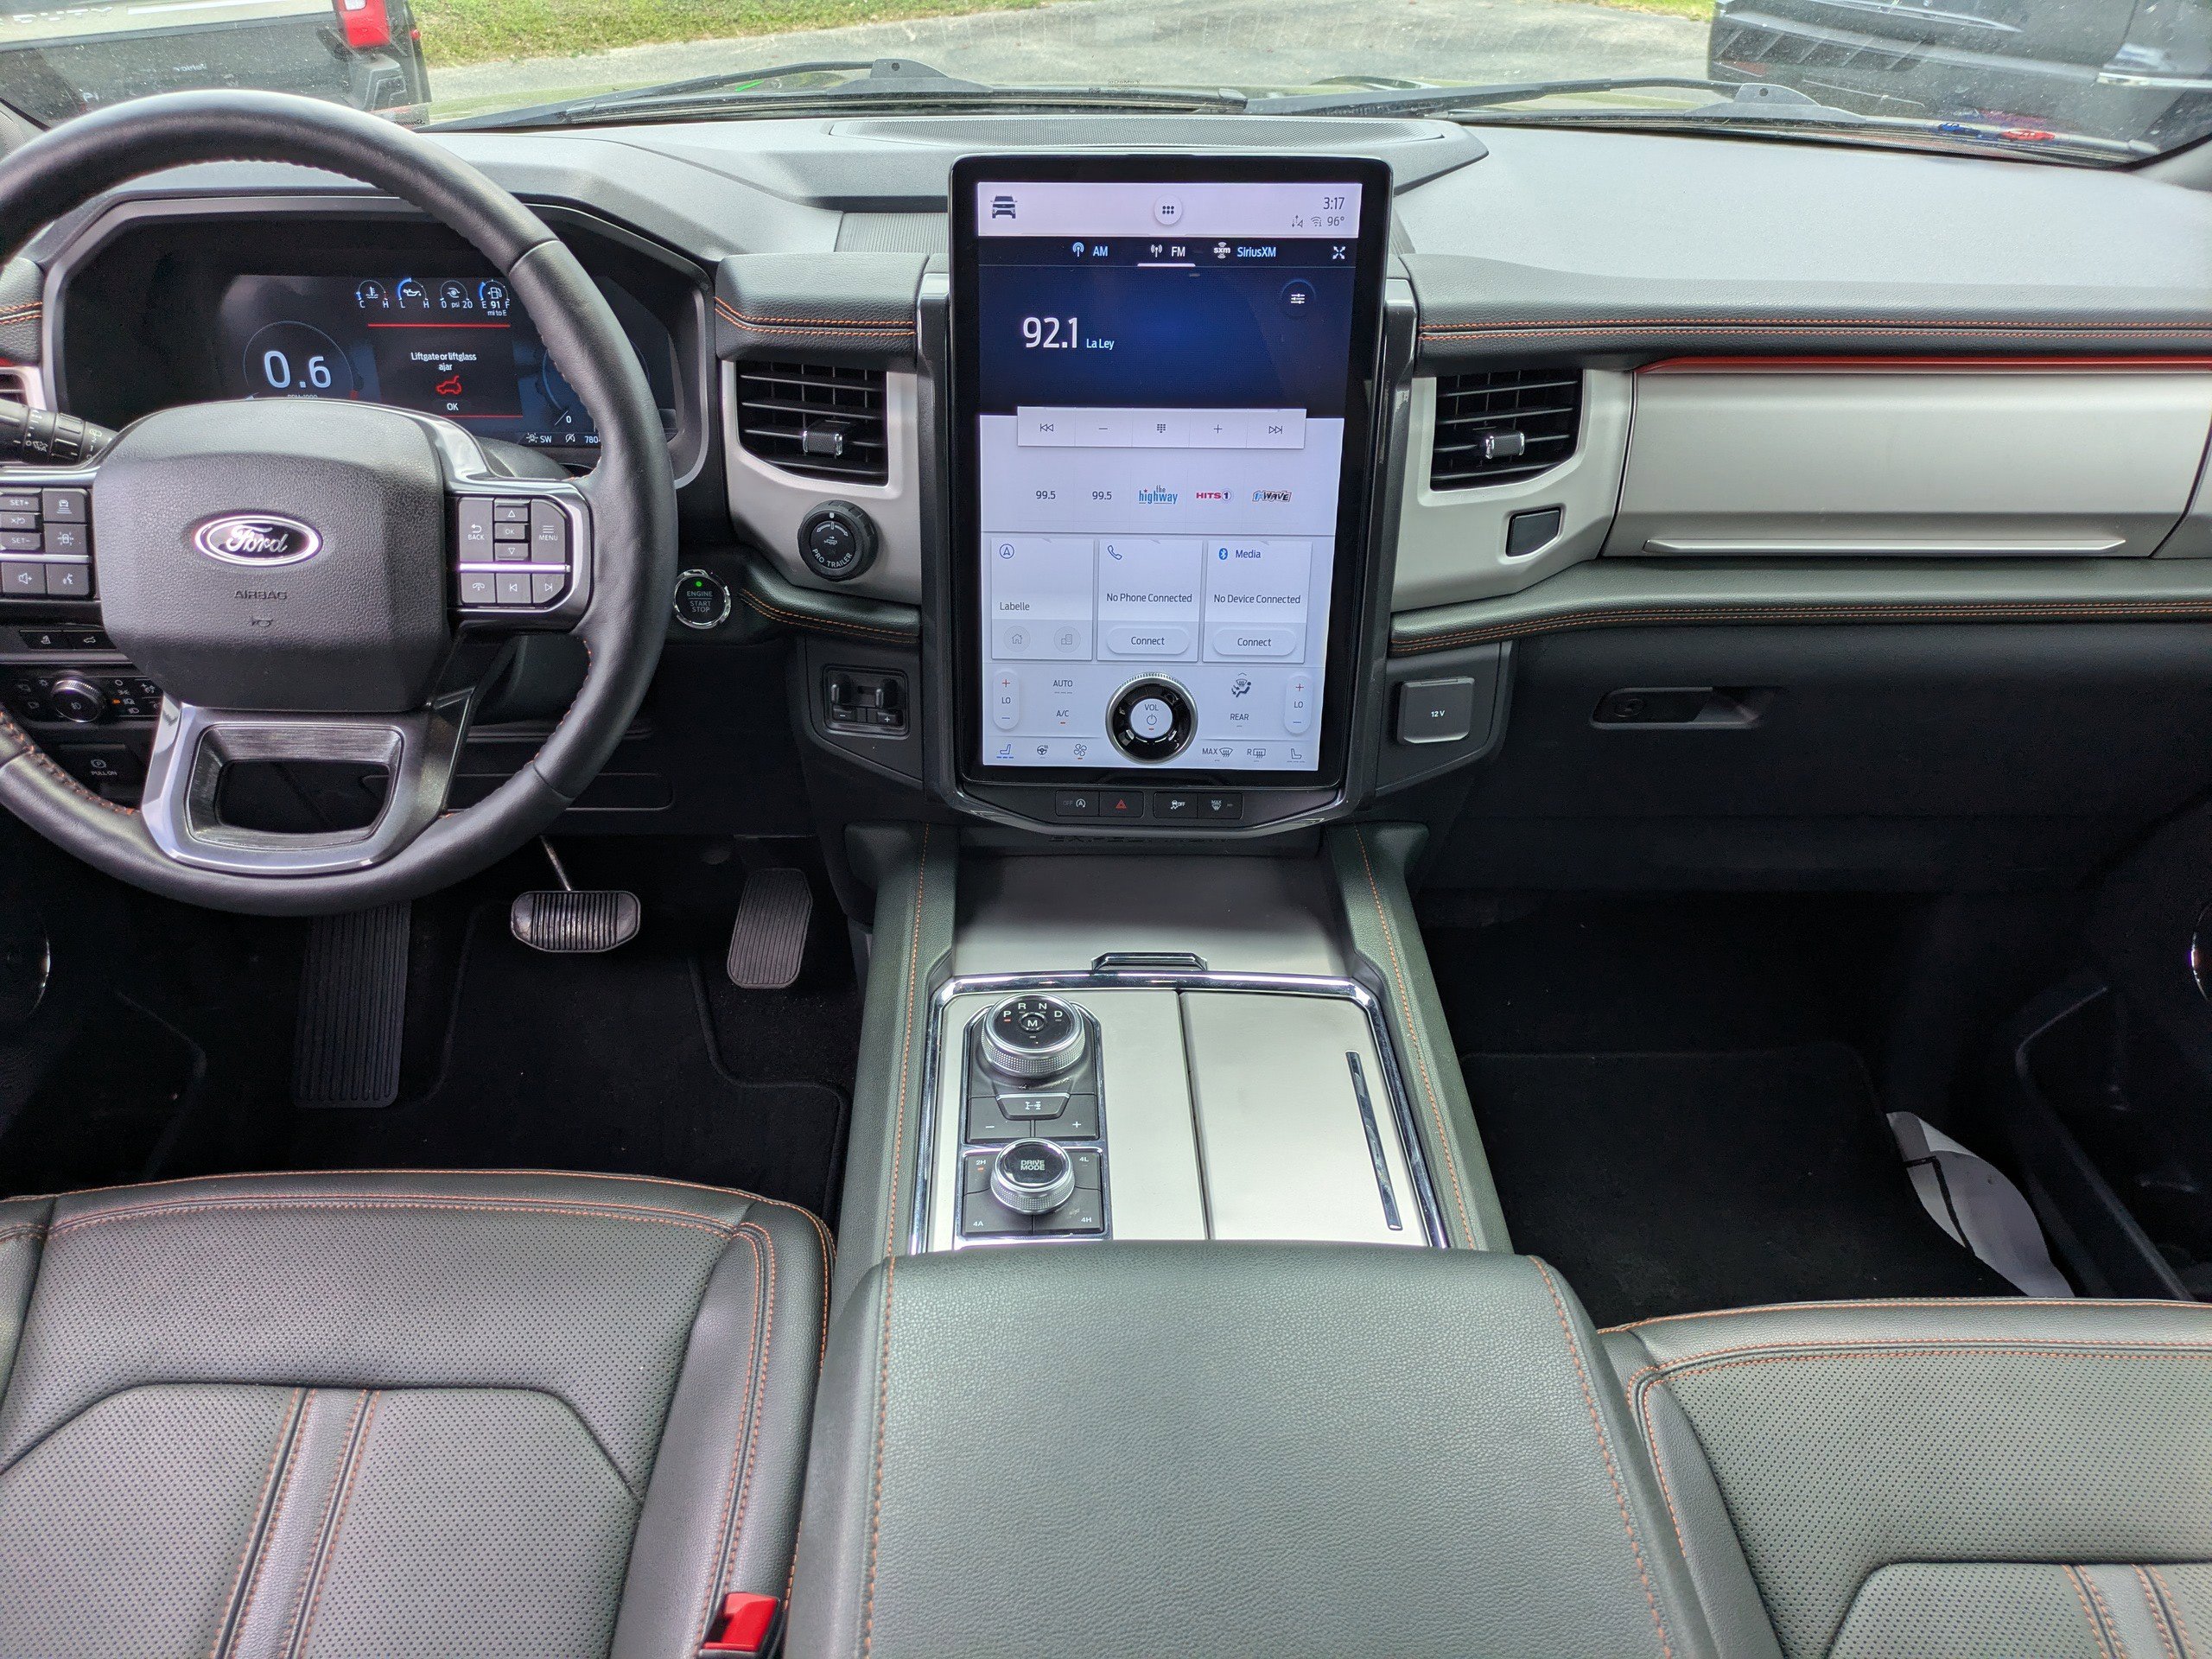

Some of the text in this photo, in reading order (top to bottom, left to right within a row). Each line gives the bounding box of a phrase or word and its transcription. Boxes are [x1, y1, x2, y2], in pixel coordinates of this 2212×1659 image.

[1323, 197, 1344, 210] 3:17
[1327, 216, 1344, 226] 96°
[1092, 246, 1109, 257] AM
[1171, 246, 1185, 257] FM
[1236, 246, 1277, 257] SiriusXM
[482, 301, 487, 309] E
[1023, 316, 1115, 351] 92.1 La Ley
[410, 352, 439, 362] Liftgate
[448, 352, 477, 362] liftglass
[438, 363, 453, 372] ajar
[447, 403, 459, 411] OK
[1156, 485, 1166, 493] the
[1035, 490, 1056, 501] 99.5
[1091, 490, 1113, 501] 99.5
[1139, 490, 1179, 505] highway
[223, 524, 289, 553] Ford
[812, 549, 853, 568] PRO TRAILER
[1235, 549, 1262, 560] Media
[234, 589, 288, 600] AIRBAG
[1106, 593, 1193, 604] No Phone Connected
[1213, 594, 1301, 605] No Device Connected
[1000, 601, 1030, 612] Labelle
[1130, 635, 1165, 646] Connect
[1237, 637, 1272, 648] Connect
[1052, 679, 1073, 689] AUTO
[1001, 696, 1011, 705] LO
[1294, 701, 1304, 709] LO
[1056, 709, 1070, 718] A/C
[1018, 1002, 1027, 1011] R
[1039, 1002, 1047, 1011] N
[1003, 1010, 1012, 1019] P
[1053, 1010, 1063, 1019] D
[1027, 1019, 1038, 1027] M
